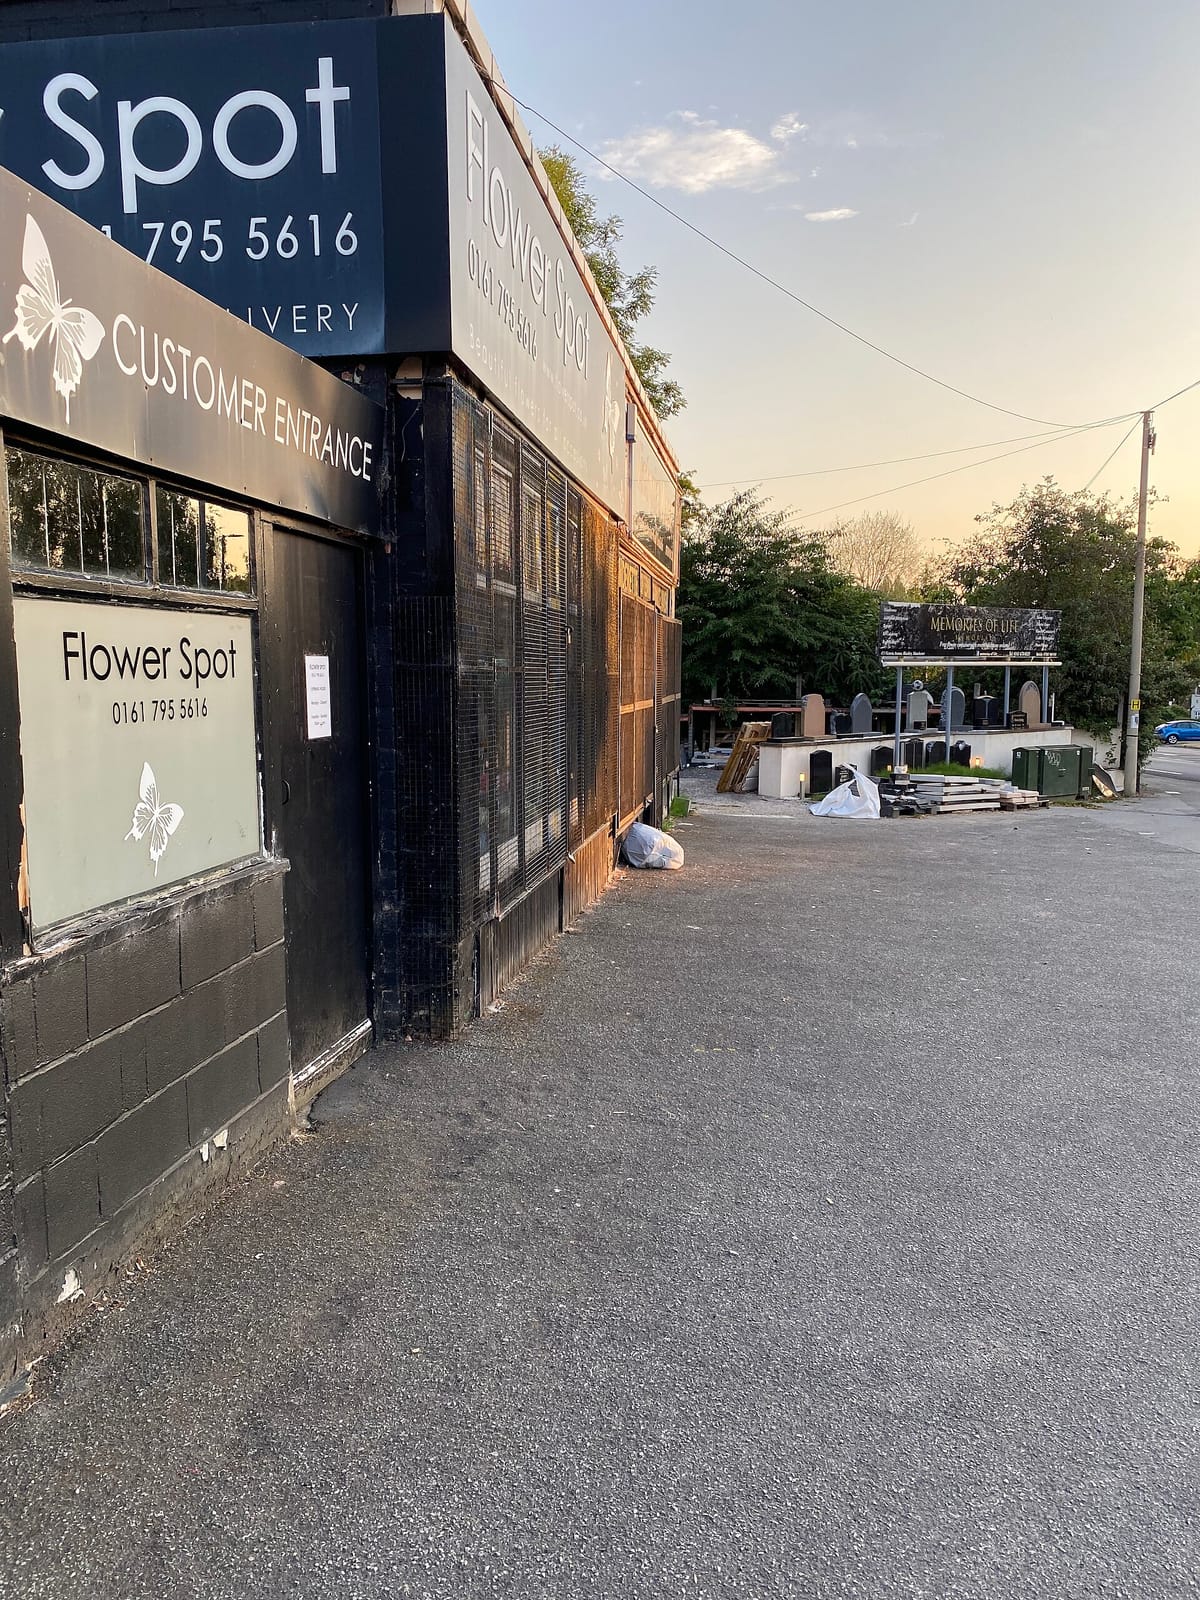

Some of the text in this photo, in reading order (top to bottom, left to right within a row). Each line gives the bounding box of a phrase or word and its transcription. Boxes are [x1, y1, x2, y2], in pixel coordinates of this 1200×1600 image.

[41, 57, 351, 215] Spot
[142, 211, 358, 264] 795 5616
[466, 89, 551, 317] Flower
[553, 258, 589, 380] Spot
[226, 302, 359, 333] IVERY
[467, 239, 537, 362] 0161 795 5616
[112, 313, 373, 481] CUSTOMER ENTRANCE
[930, 616, 1019, 633] MEMORIES OF LIFE
[63, 631, 237, 688] Flower Spot
[112, 697, 208, 724] 0161 795 5616
[1132, 701, 1140, 710] H
